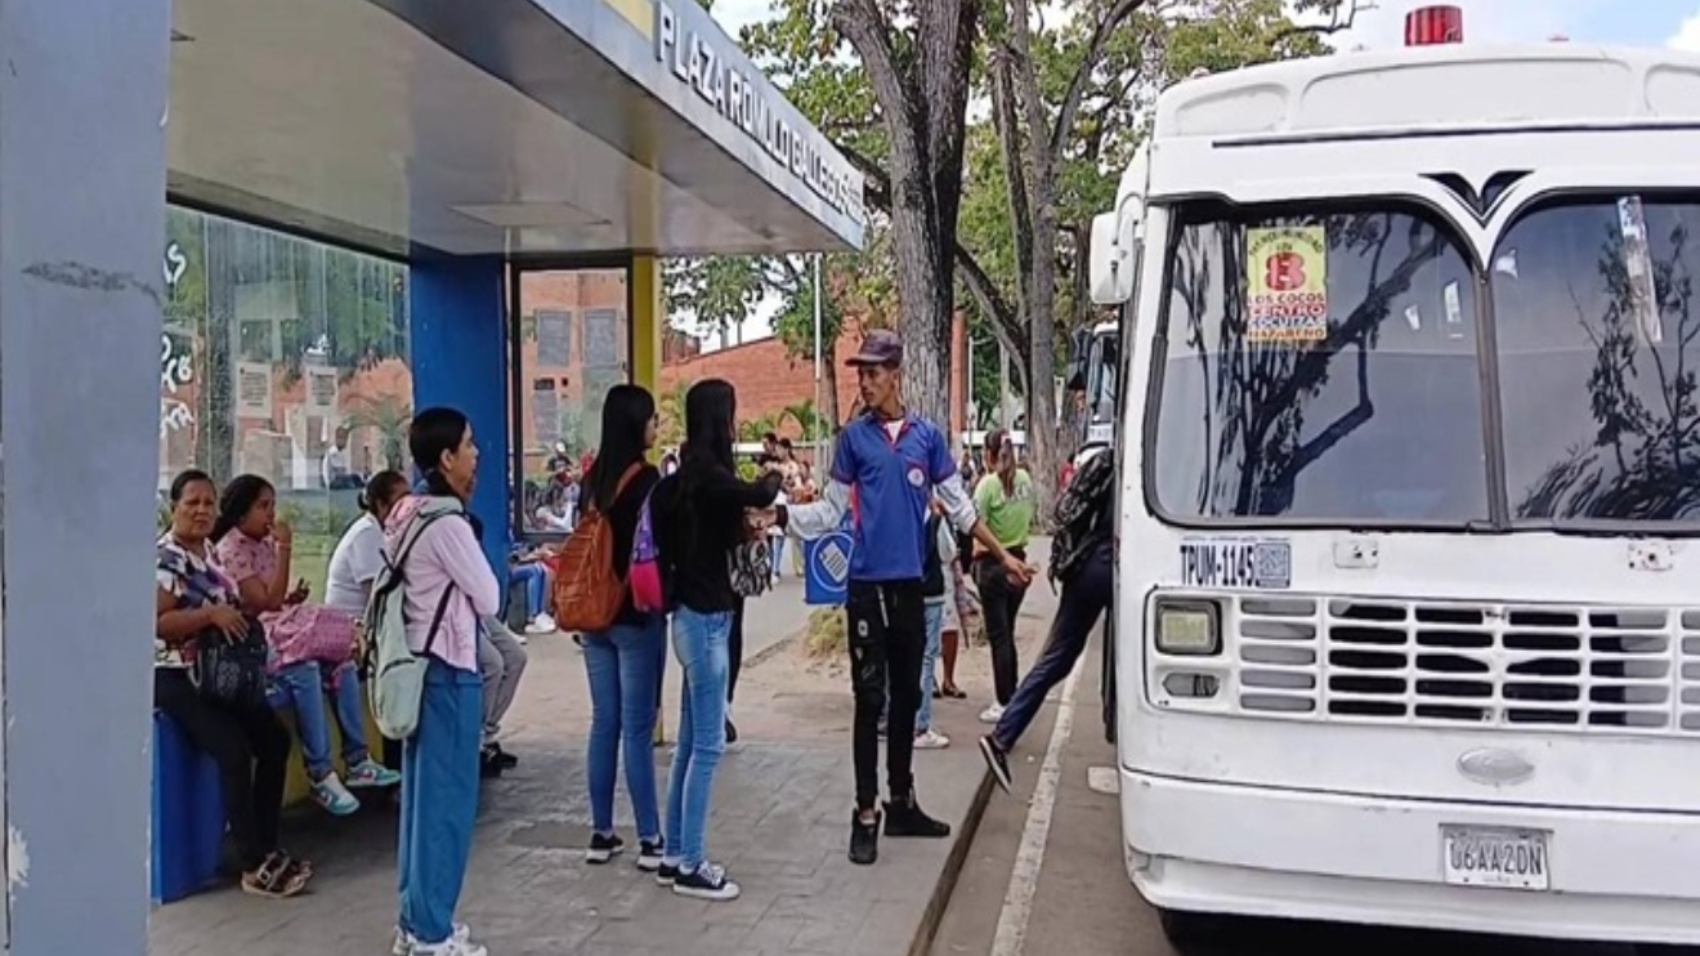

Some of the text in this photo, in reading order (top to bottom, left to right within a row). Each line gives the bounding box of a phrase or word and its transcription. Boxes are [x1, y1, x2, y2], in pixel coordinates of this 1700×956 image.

[659, 1, 726, 111] PLAZA
[1248, 304, 1326, 317] CENTRO
[1278, 293, 1325, 304] COCOS
[1180, 545, 1254, 585] TPUM-1145
